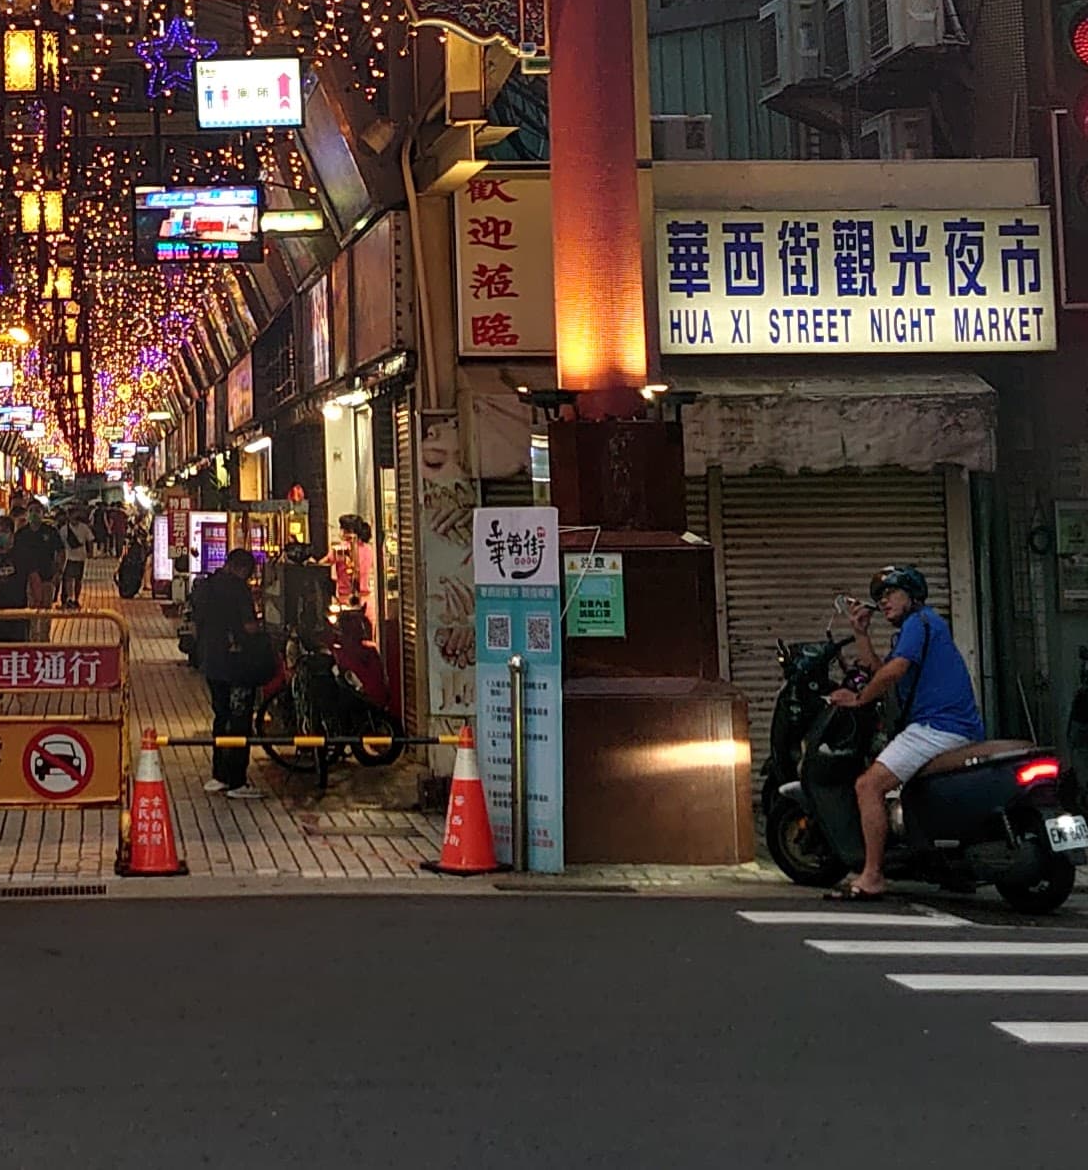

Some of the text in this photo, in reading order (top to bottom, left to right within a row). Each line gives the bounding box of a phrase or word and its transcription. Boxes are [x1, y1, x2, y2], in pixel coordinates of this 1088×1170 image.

[667, 217, 1042, 298] 華西街觀光夜市
[670, 307, 1044, 344] HUA XI STREET NIGHT MARKET
